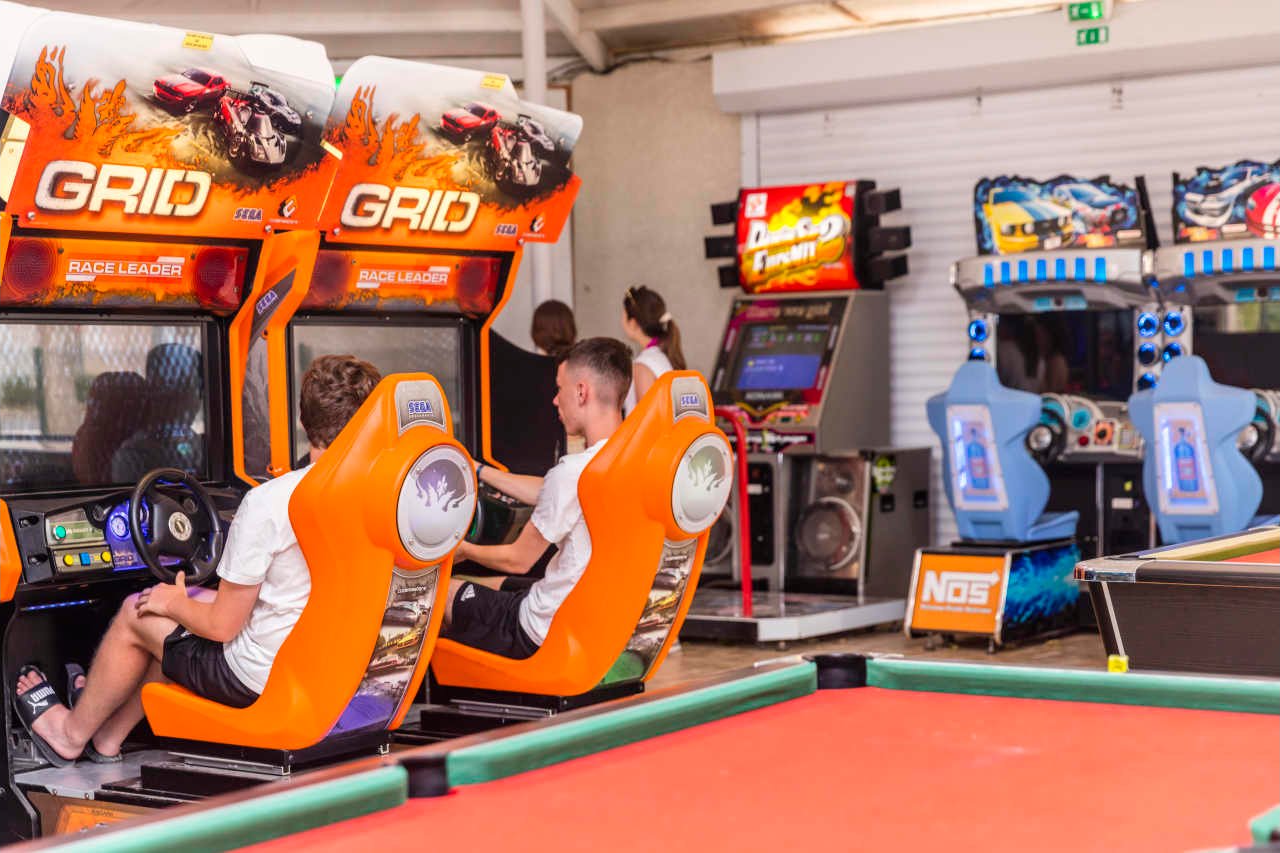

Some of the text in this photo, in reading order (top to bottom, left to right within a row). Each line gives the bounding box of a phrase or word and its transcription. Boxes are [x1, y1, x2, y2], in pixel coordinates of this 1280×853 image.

[35, 160, 212, 217] GRID
[233, 207, 262, 221] SEGA
[340, 183, 480, 232] GRID
[495, 224, 518, 236] SEGA
[68, 261, 182, 276] RACE LEADER
[359, 270, 449, 284] RACE LEADER
[256, 289, 278, 314] SEGA
[408, 400, 432, 414] SEGA
